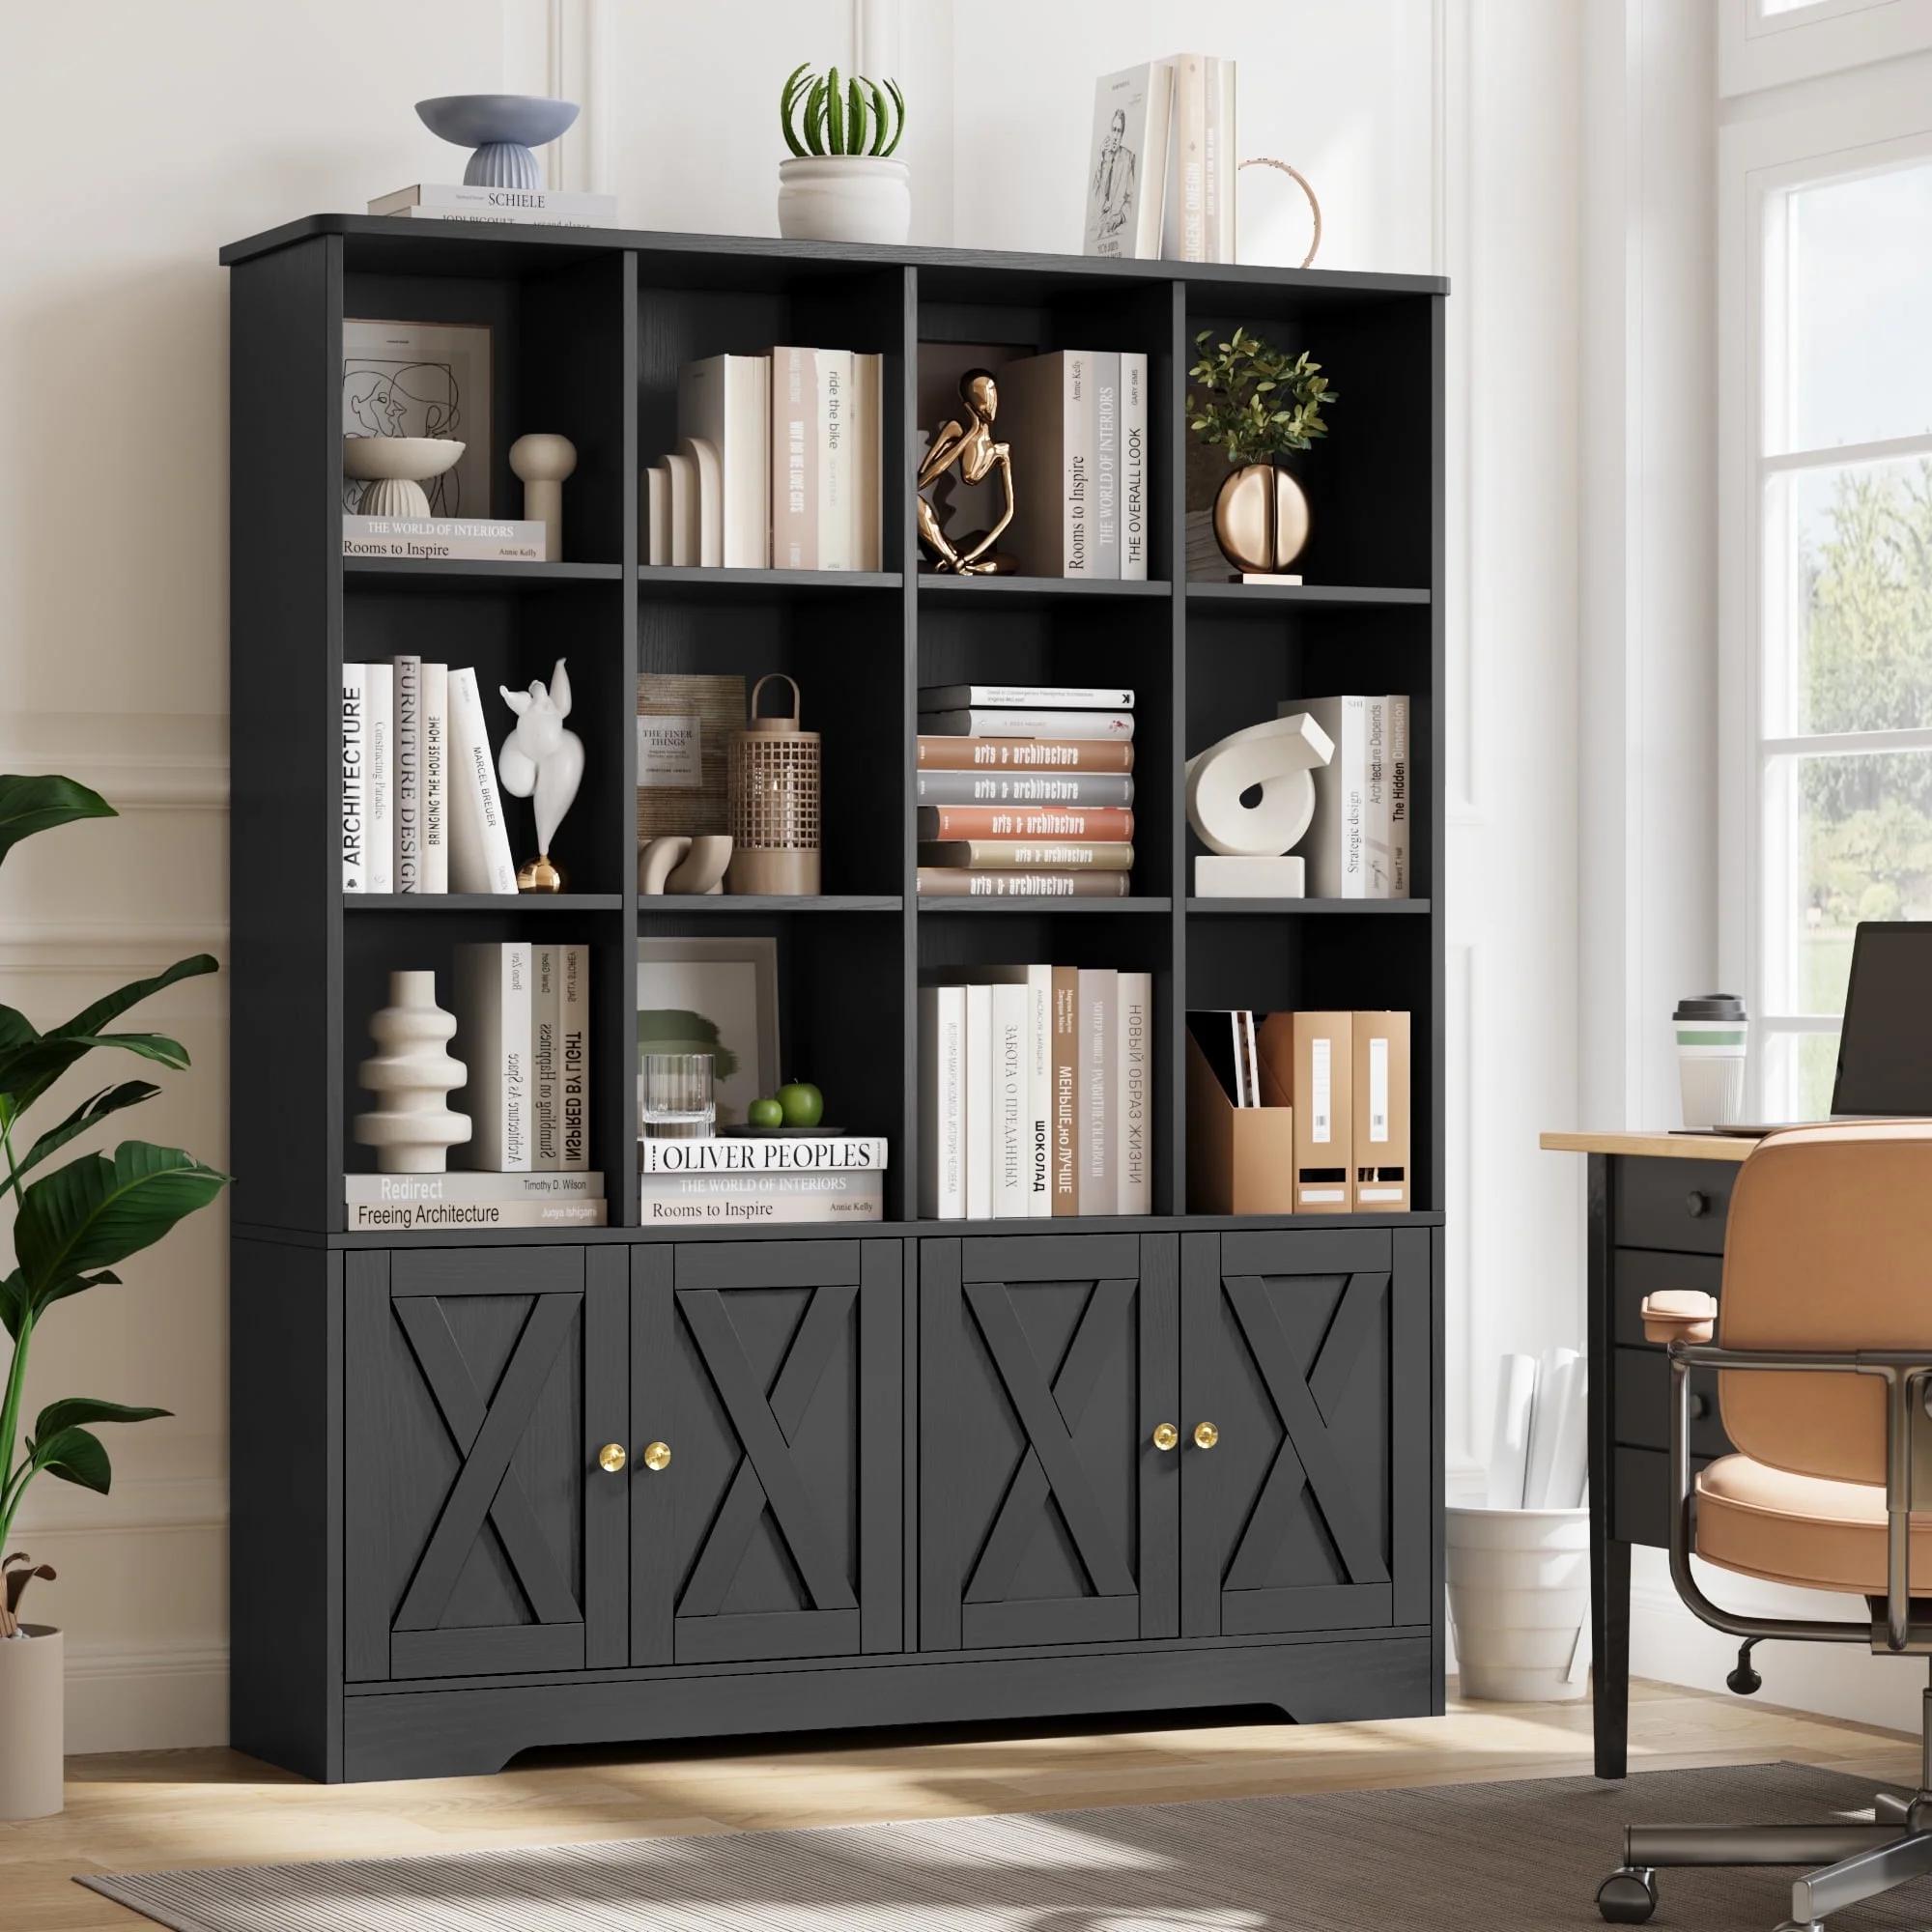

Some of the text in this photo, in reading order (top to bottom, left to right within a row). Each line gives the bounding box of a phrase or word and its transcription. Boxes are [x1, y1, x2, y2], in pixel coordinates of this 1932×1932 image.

[488, 192, 546, 209] SCHIELE
[829, 371, 840, 395] ride
[1072, 360, 1084, 402] Annie Kelly
[829, 399, 840, 419] the
[829, 422, 840, 450] bike
[1099, 386, 1114, 547] THE WORLD OF INTERIORS
[1128, 427, 1141, 564] THE OVERALL LOOK
[1068, 456, 1089, 570] Rooms to Inspire
[368, 522, 514, 538] THE WORLD OF INTERIORS
[343, 540, 449, 560] Rooms to Inspire
[498, 548, 537, 558] Annie Kelly
[665, 730, 693, 739] FINER
[975, 744, 1079, 765] arts & architecture
[1370, 703, 1382, 805] Architecture Depends
[1392, 702, 1405, 822] The Hidden Dimension
[343, 687, 361, 867] ARCHITECTURE
[400, 661, 417, 895] FURNITURE DESIGN
[428, 716, 440, 845] BRINGING THE HOUSE HOME
[472, 746, 497, 828] MARCEL BREUER
[975, 779, 1079, 800] arts & architecture
[992, 814, 1085, 835] arts & architecture
[1015, 846, 1093, 863] arts & architecture
[1348, 827, 1362, 874] Strategic
[970, 874, 1074, 895] arts & architecture
[1005, 1023, 1019, 1189] ЗАБОТА О ПРЕДАННЫХ
[1128, 1004, 1145, 1184] НОВЫЙ ОБРАЗ ЖИЗНИ
[663, 1145, 755, 1170] OLIVER
[764, 1143, 870, 1169] PEOPLES
[1033, 1120, 1045, 1192] ШОКОЛАД
[1058, 1147, 1072, 1194] ЛУЧШЕ
[381, 1178, 442, 1200] Redirect
[523, 1179, 586, 1191] Timothy D. Wilson
[680, 1176, 847, 1193] THE WORLD OF INTERIORS
[358, 1204, 499, 1229] Freeing Architecture
[652, 1200, 774, 1220] Rooms to Inspire
[829, 1201, 873, 1214] Annie Kelly
